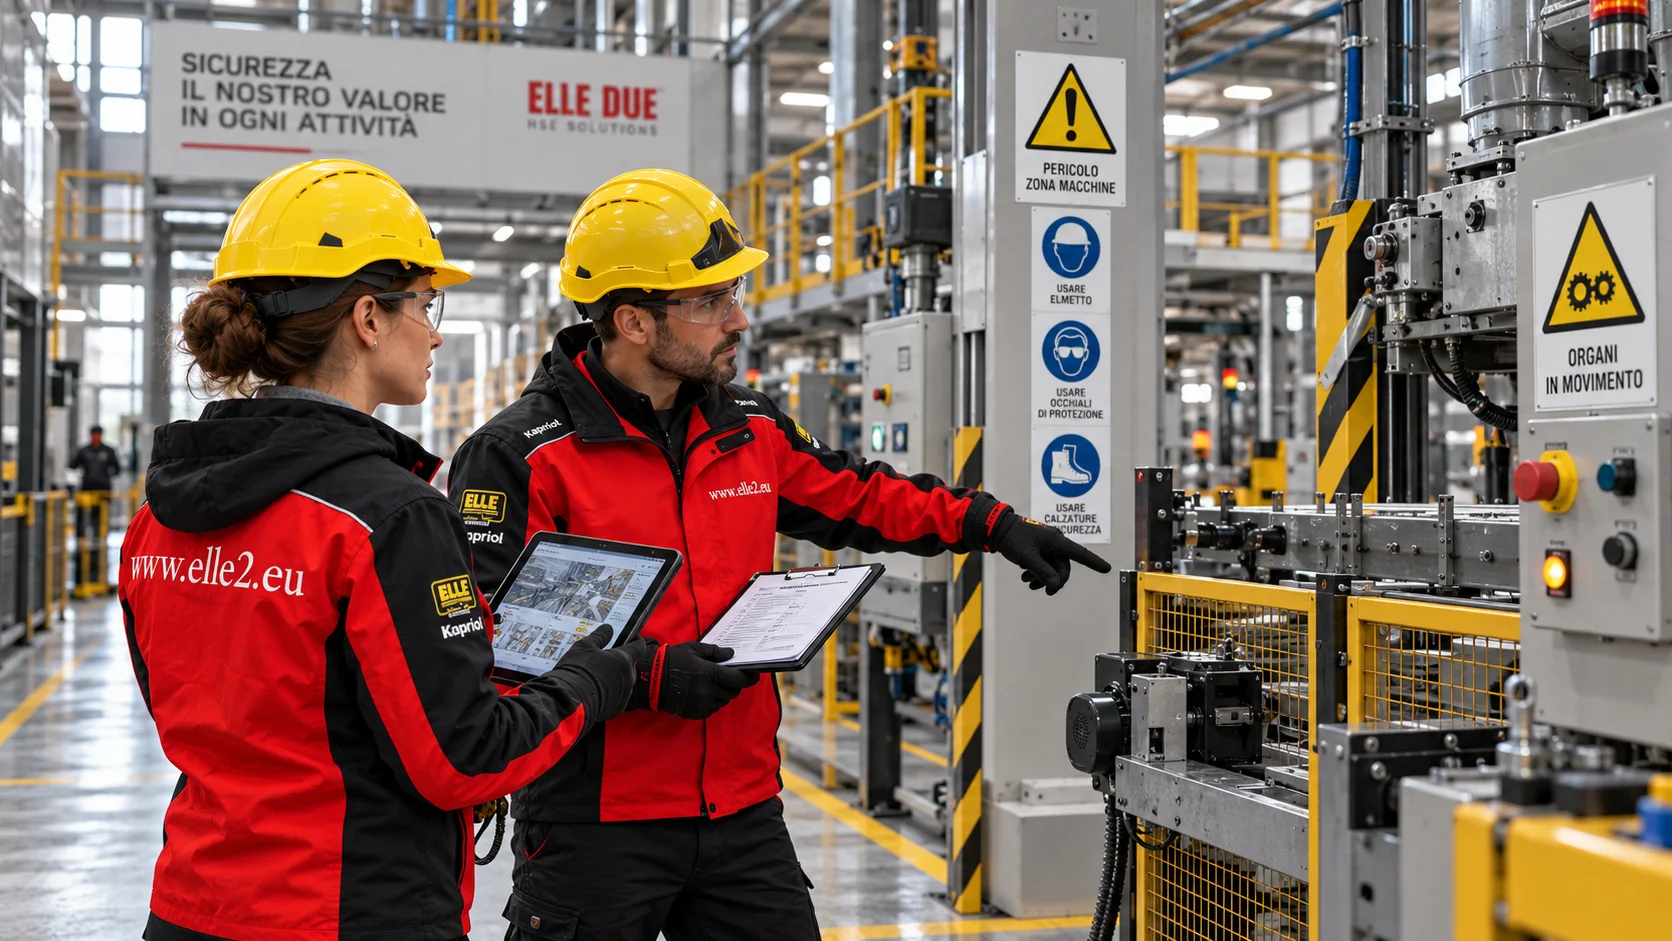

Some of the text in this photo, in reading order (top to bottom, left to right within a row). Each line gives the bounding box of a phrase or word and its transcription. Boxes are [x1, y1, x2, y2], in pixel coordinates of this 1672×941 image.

[181, 52, 332, 80] SICUREZZA
[181, 79, 447, 114] IL NOSTRO VALORE
[528, 80, 658, 120] ELLE DUE
[181, 105, 418, 137] IN OGNI ATTIVITÀ
[527, 119, 658, 136] HSE SOLUTIONS
[1043, 162, 1099, 177] PERICOLO
[1026, 178, 1116, 194] ZONA MACCHINE
[1056, 284, 1086, 294] USARE
[1050, 295, 1092, 305] ELMETTO
[1568, 344, 1618, 367] ORGANI
[1546, 369, 1643, 395] IN MOVIMENTO
[1056, 388, 1086, 397] USARE
[1050, 398, 1092, 408] OCCHIALI
[1038, 409, 1103, 419] DI PROTEZIONE
[708, 480, 772, 500] www.elle2.eu
[464, 493, 499, 510] ELLE
[1056, 503, 1086, 513] USARE
[1044, 514, 1097, 524] CALZATURE
[467, 531, 504, 544] apriol
[1057, 525, 1102, 534] CUREZZA
[131, 545, 304, 596] www.elle2.eu
[437, 579, 470, 602] ELLE
[441, 616, 484, 639] Kapriol
